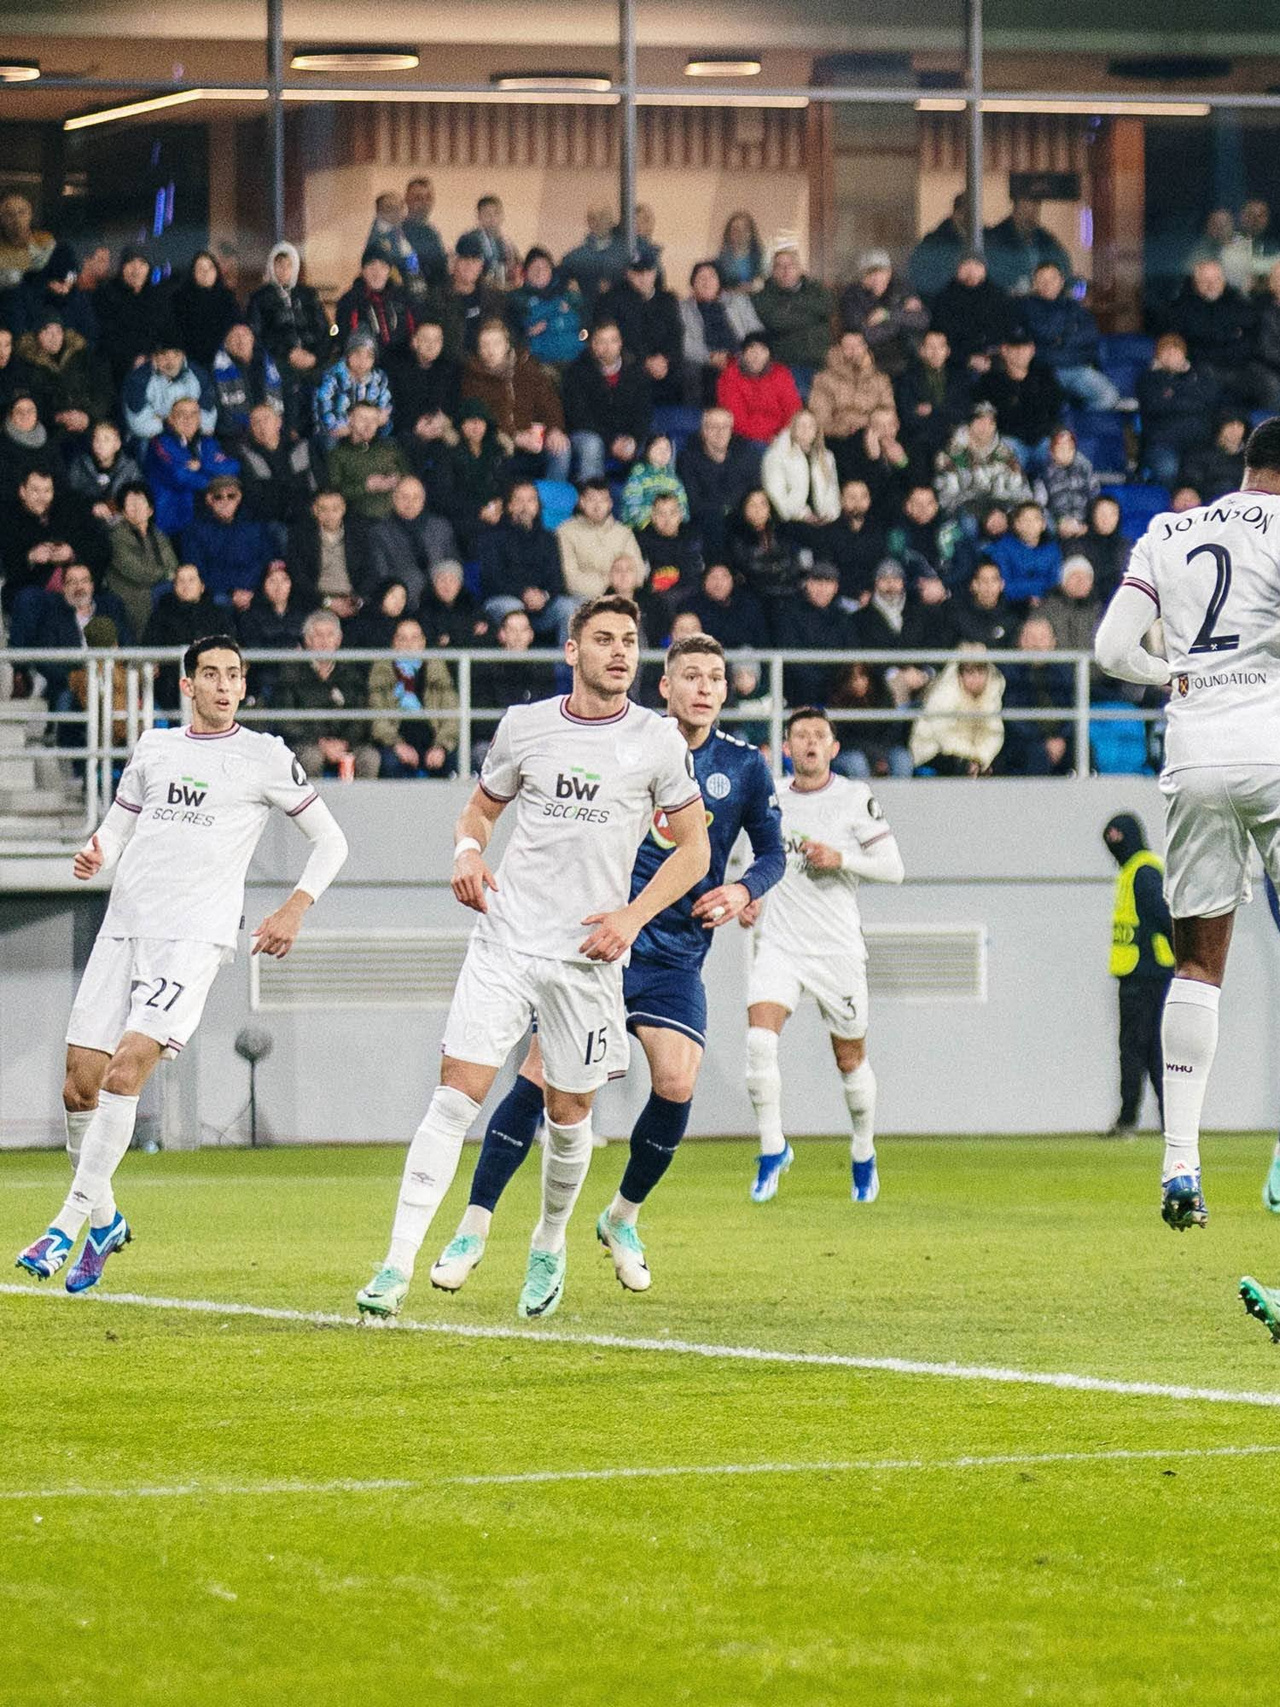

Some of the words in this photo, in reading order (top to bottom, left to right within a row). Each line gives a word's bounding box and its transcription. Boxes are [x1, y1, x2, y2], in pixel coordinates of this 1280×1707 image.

[1186, 543, 1240, 655] 2
[1191, 673, 1267, 690] FOUNDATION
[167, 782, 207, 808] bw
[556, 773, 600, 802] bw
[542, 803, 610, 824] SCORES
[145, 976, 185, 1012] 27
[842, 995, 857, 1022] 3
[584, 1025, 608, 1066] 15
[1165, 1062, 1193, 1074] WHU
